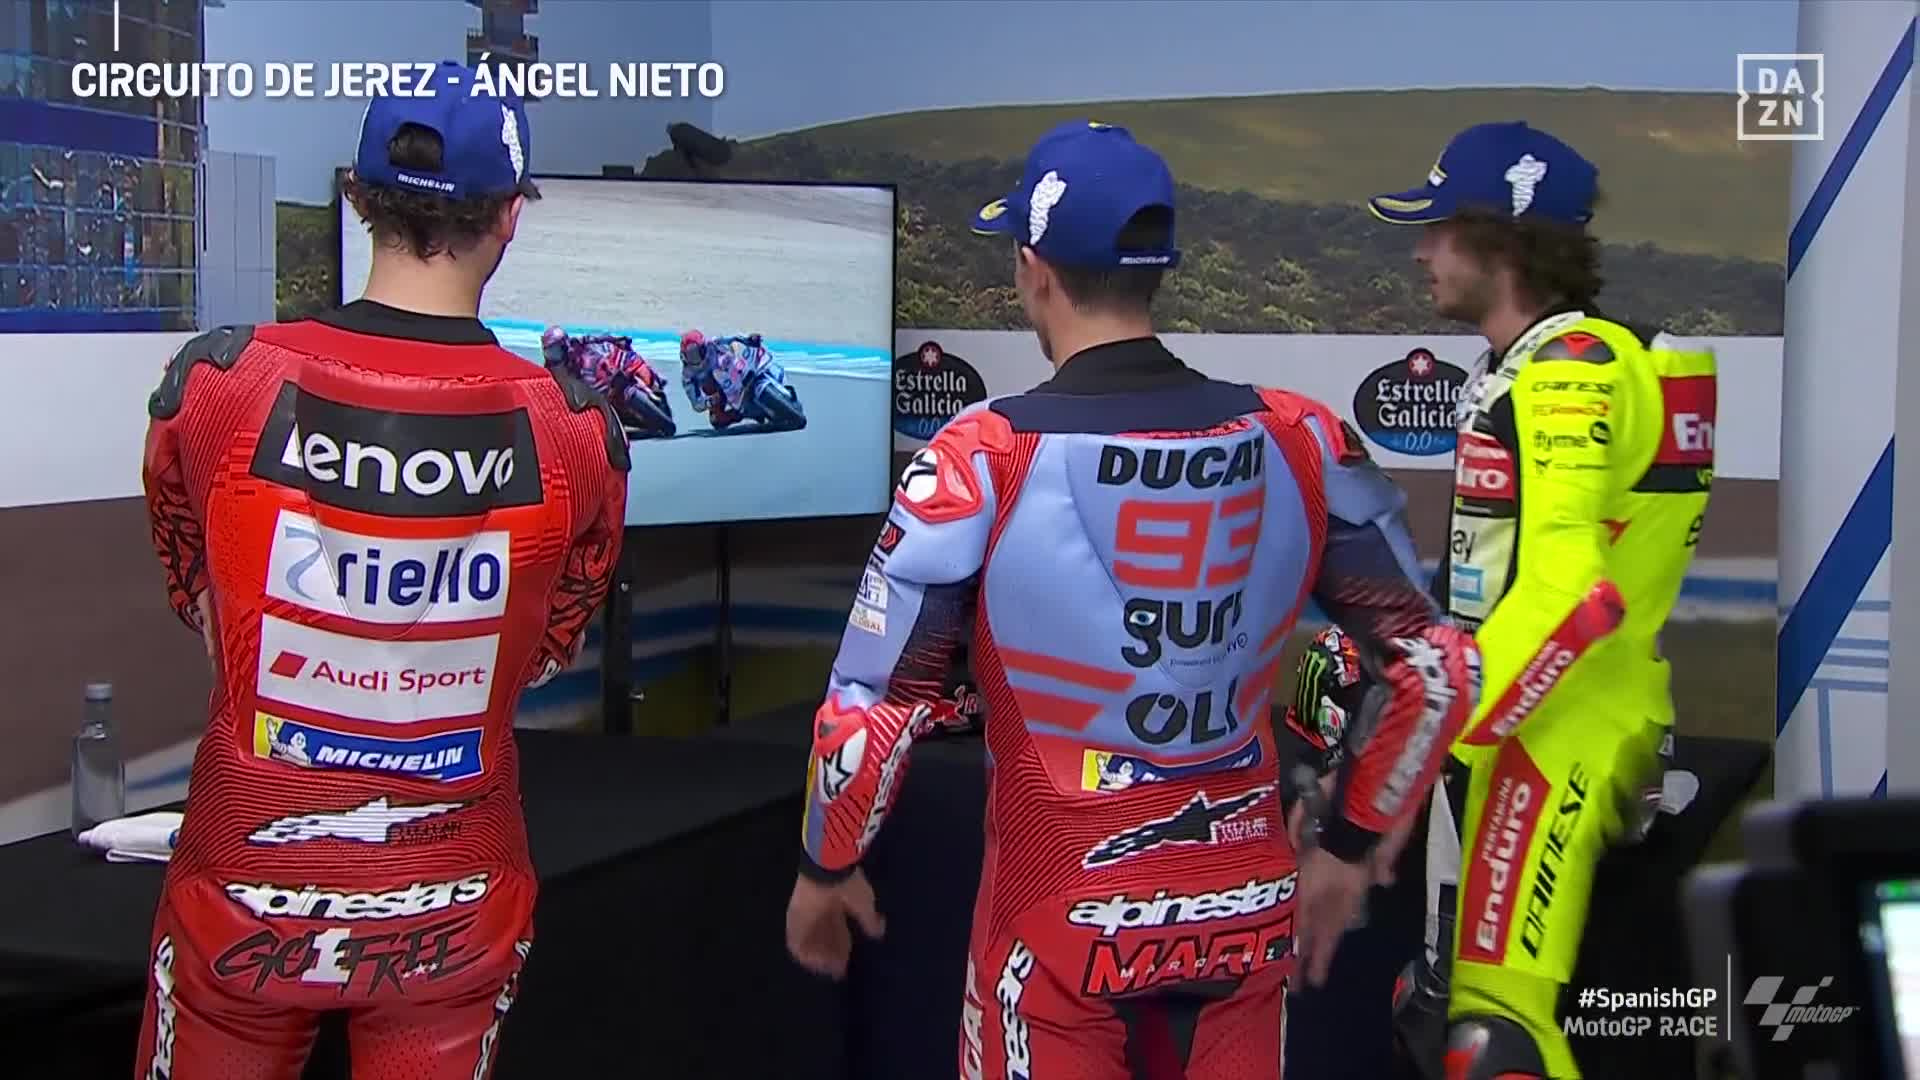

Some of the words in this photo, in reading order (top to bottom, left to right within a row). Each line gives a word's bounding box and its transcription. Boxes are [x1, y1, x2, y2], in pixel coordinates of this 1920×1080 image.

[397, 173, 455, 192] MICHELIN
[1113, 486, 1265, 590] 93
[336, 547, 501, 606] riello
[311, 660, 389, 692] Audi
[399, 666, 487, 693] Sport
[315, 745, 465, 772] MICHELIN
[1475, 781, 1531, 952] Enduro
[224, 873, 490, 919] alpinestars
[1068, 872, 1298, 936] alpinestars
